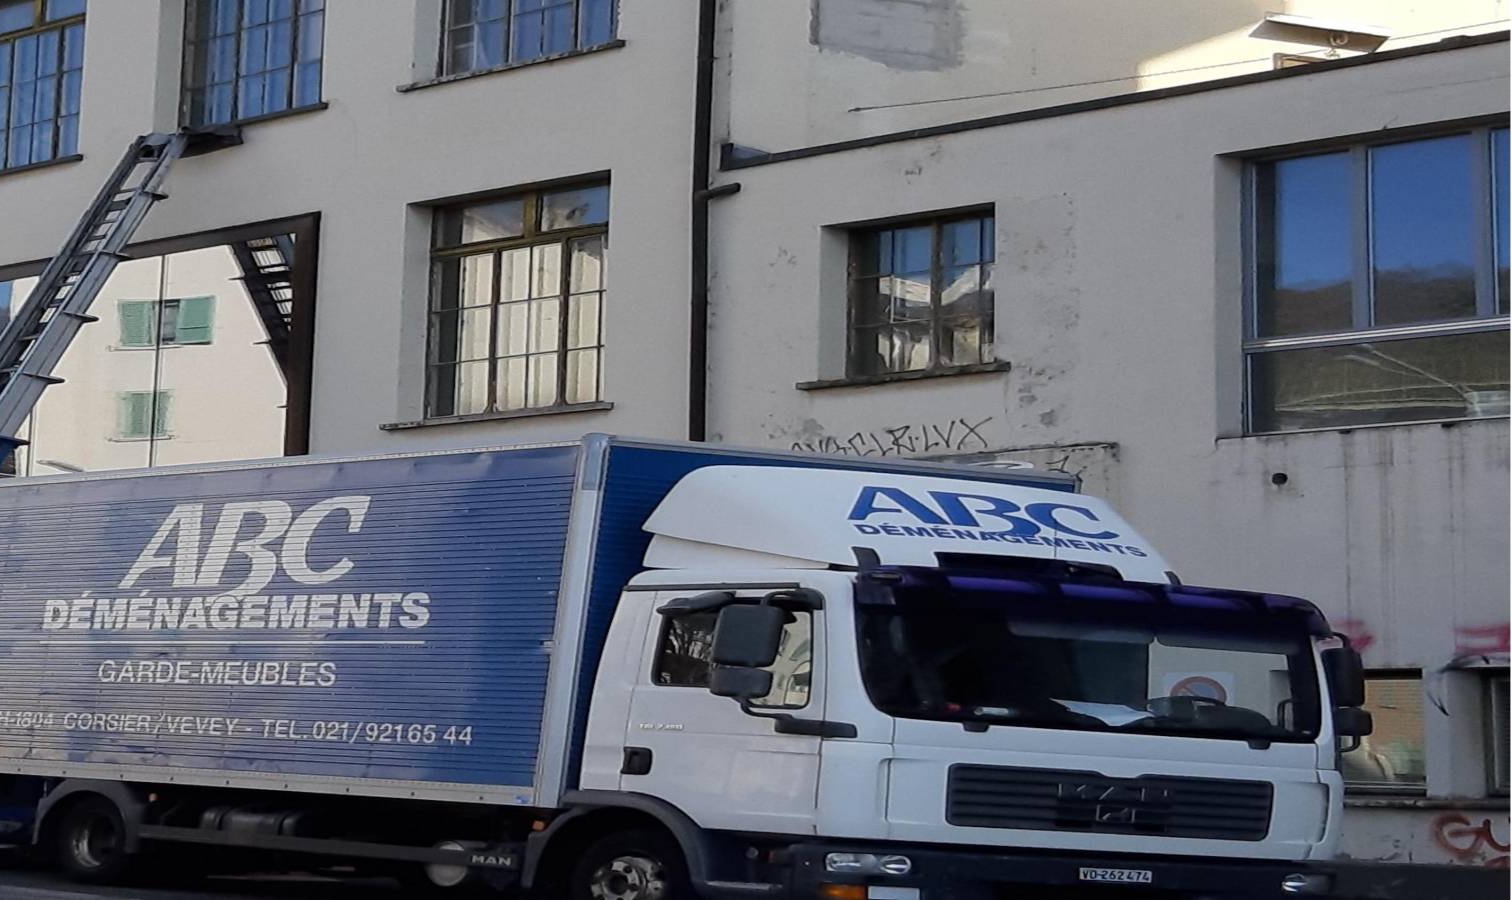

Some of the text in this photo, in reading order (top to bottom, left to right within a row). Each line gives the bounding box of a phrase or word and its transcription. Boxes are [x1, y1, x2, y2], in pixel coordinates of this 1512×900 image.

[848, 485, 1120, 541] ABC
[118, 495, 372, 599] ABC
[852, 522, 1148, 558] DÉMÉNAGEMENTS
[41, 589, 431, 631] DÉMÉNAGEMENTS
[97, 659, 338, 688] GARDE-MEUBLES
[443, 725, 473, 746] 44
[471, 853, 512, 867] MAN
